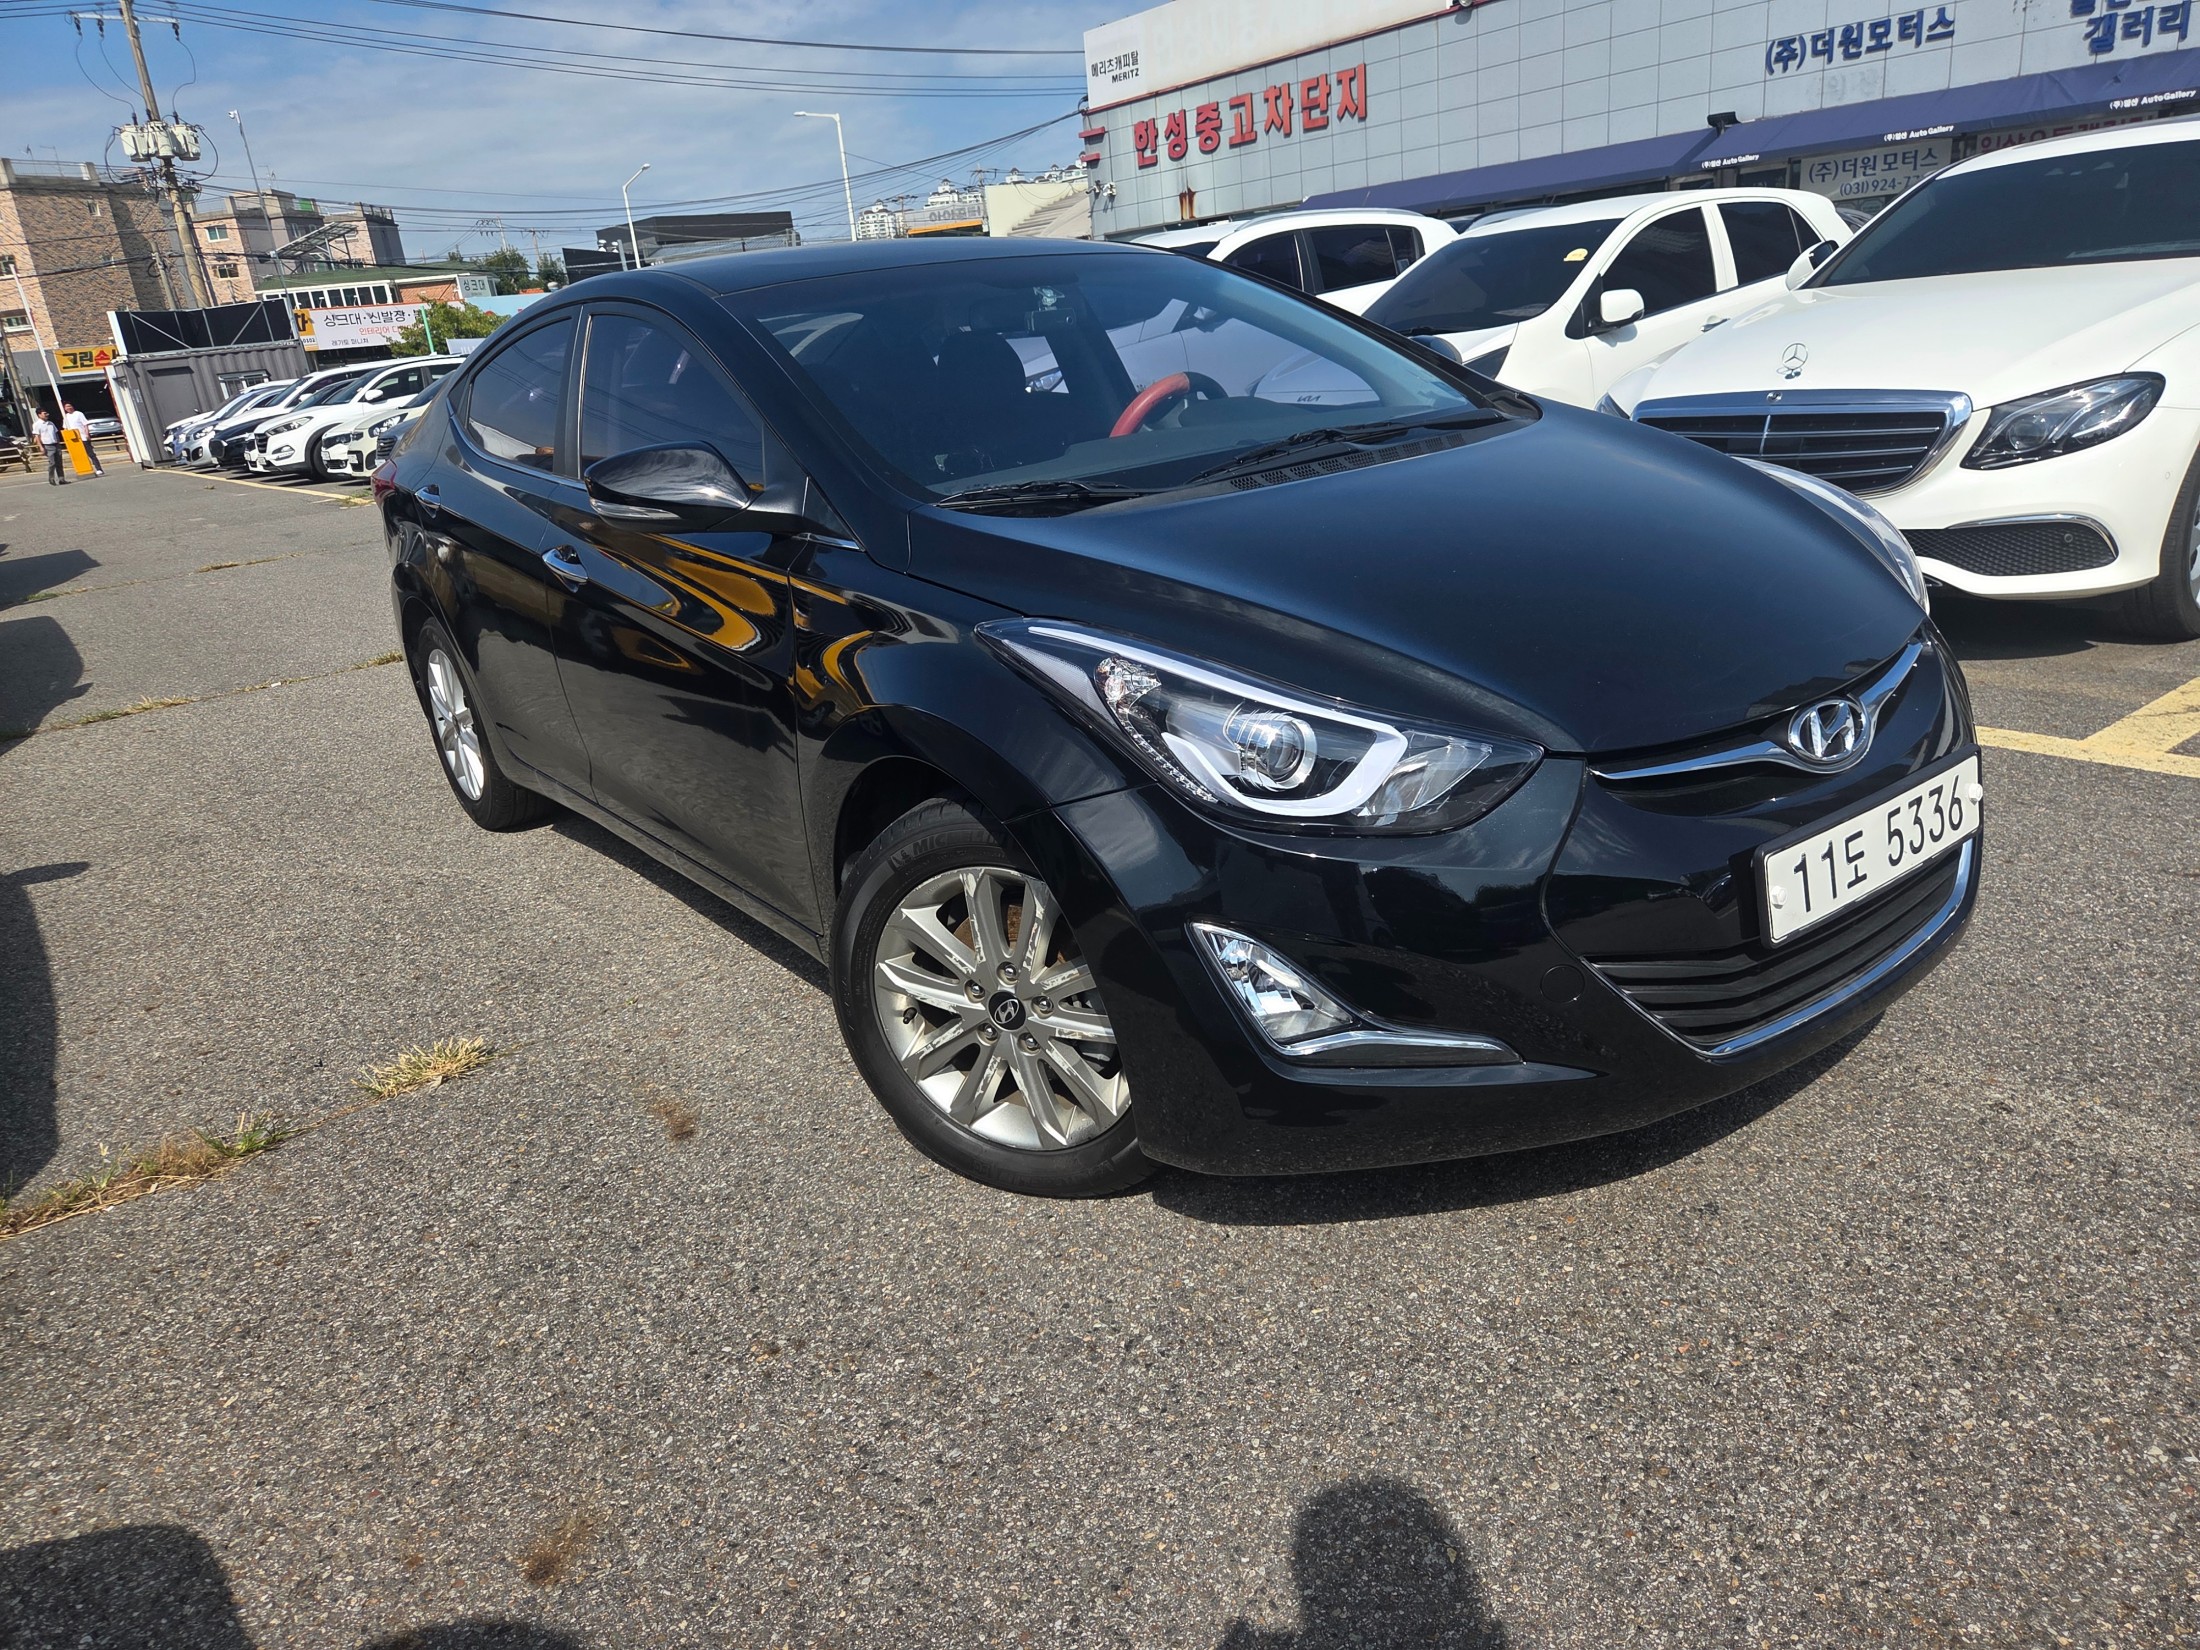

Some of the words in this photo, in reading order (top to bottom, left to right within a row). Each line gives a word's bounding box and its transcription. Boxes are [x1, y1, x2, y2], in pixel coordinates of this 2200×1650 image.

[2083, 0, 2191, 55] 갤러리
[1091, 50, 1139, 77] 메리츠캐피탈
[1111, 68, 1140, 83] MERITZ
[1134, 63, 1367, 169] 한성중고차단지
[1793, 830, 1868, 913] 11도
[1887, 774, 1964, 867] 5336
